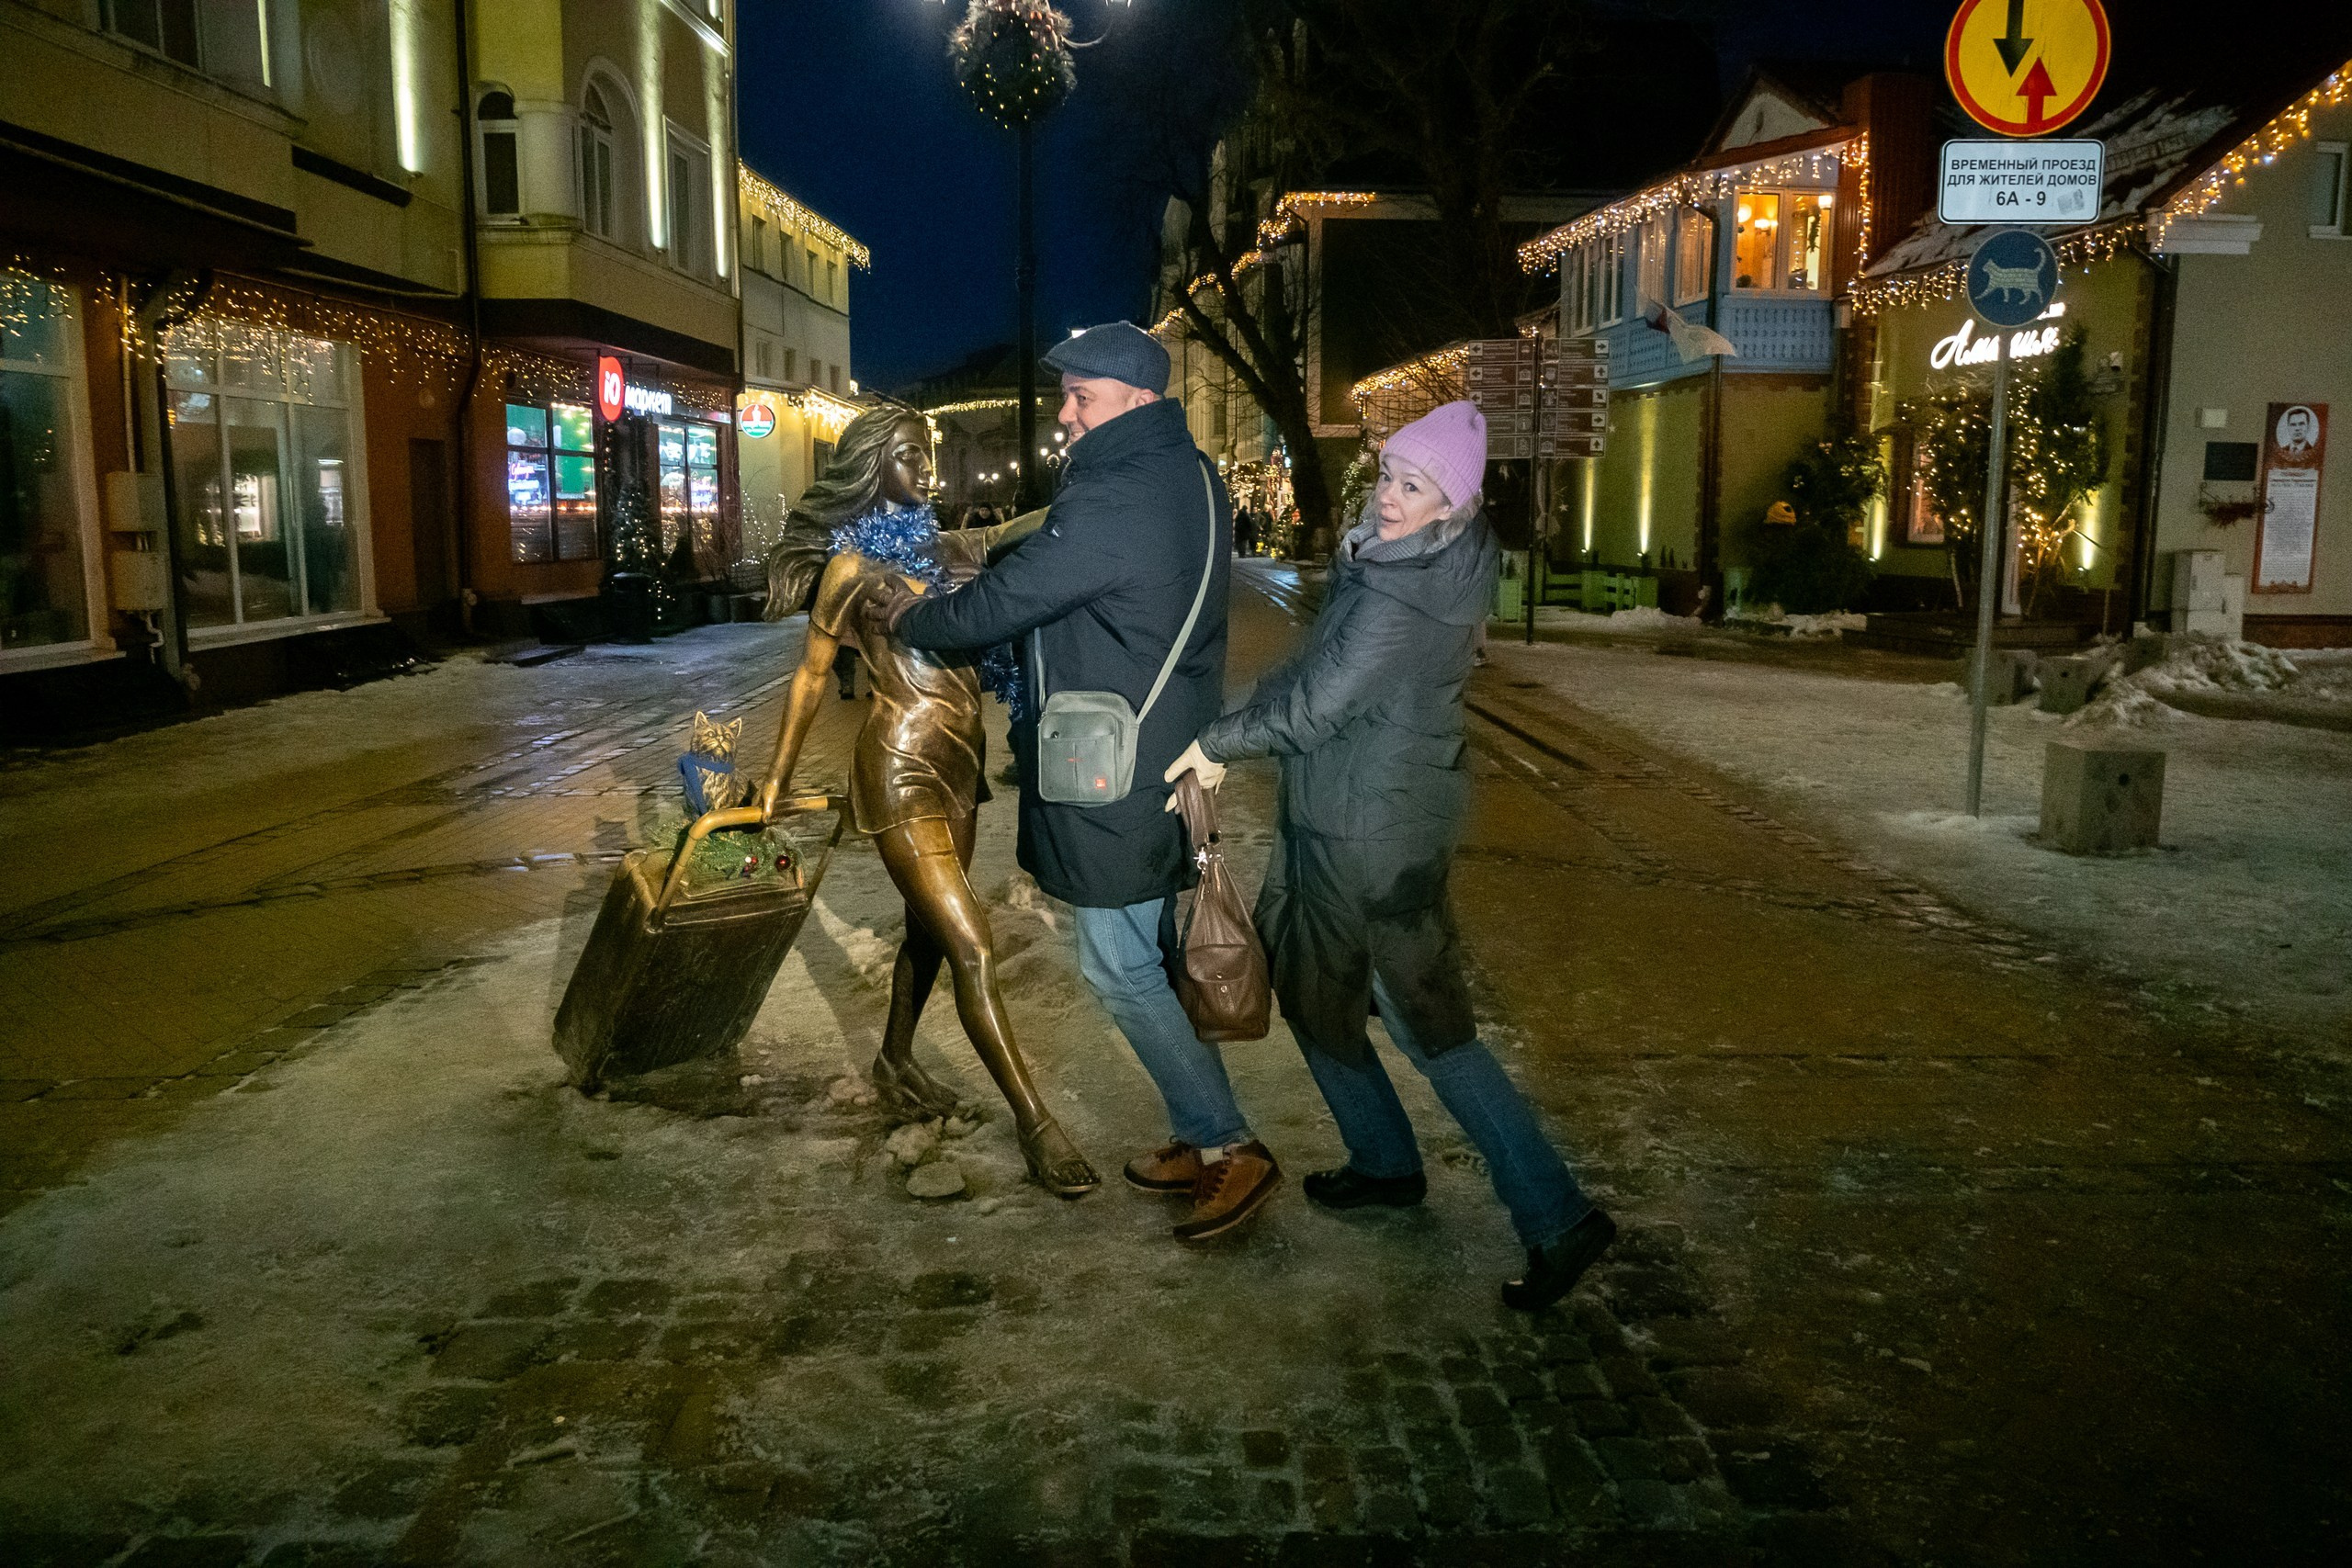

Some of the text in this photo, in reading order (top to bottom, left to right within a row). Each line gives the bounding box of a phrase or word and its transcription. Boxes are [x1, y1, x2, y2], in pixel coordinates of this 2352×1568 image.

[1951, 157, 2097, 173] ВРЕМЕННЫЙ ПРОЕЗД
[1947, 172, 2098, 187] ДЛЯ ЖИТЕЛЕЙ ДОМОВ
[2036, 190, 2047, 206] 9
[625, 385, 673, 416] маркет
